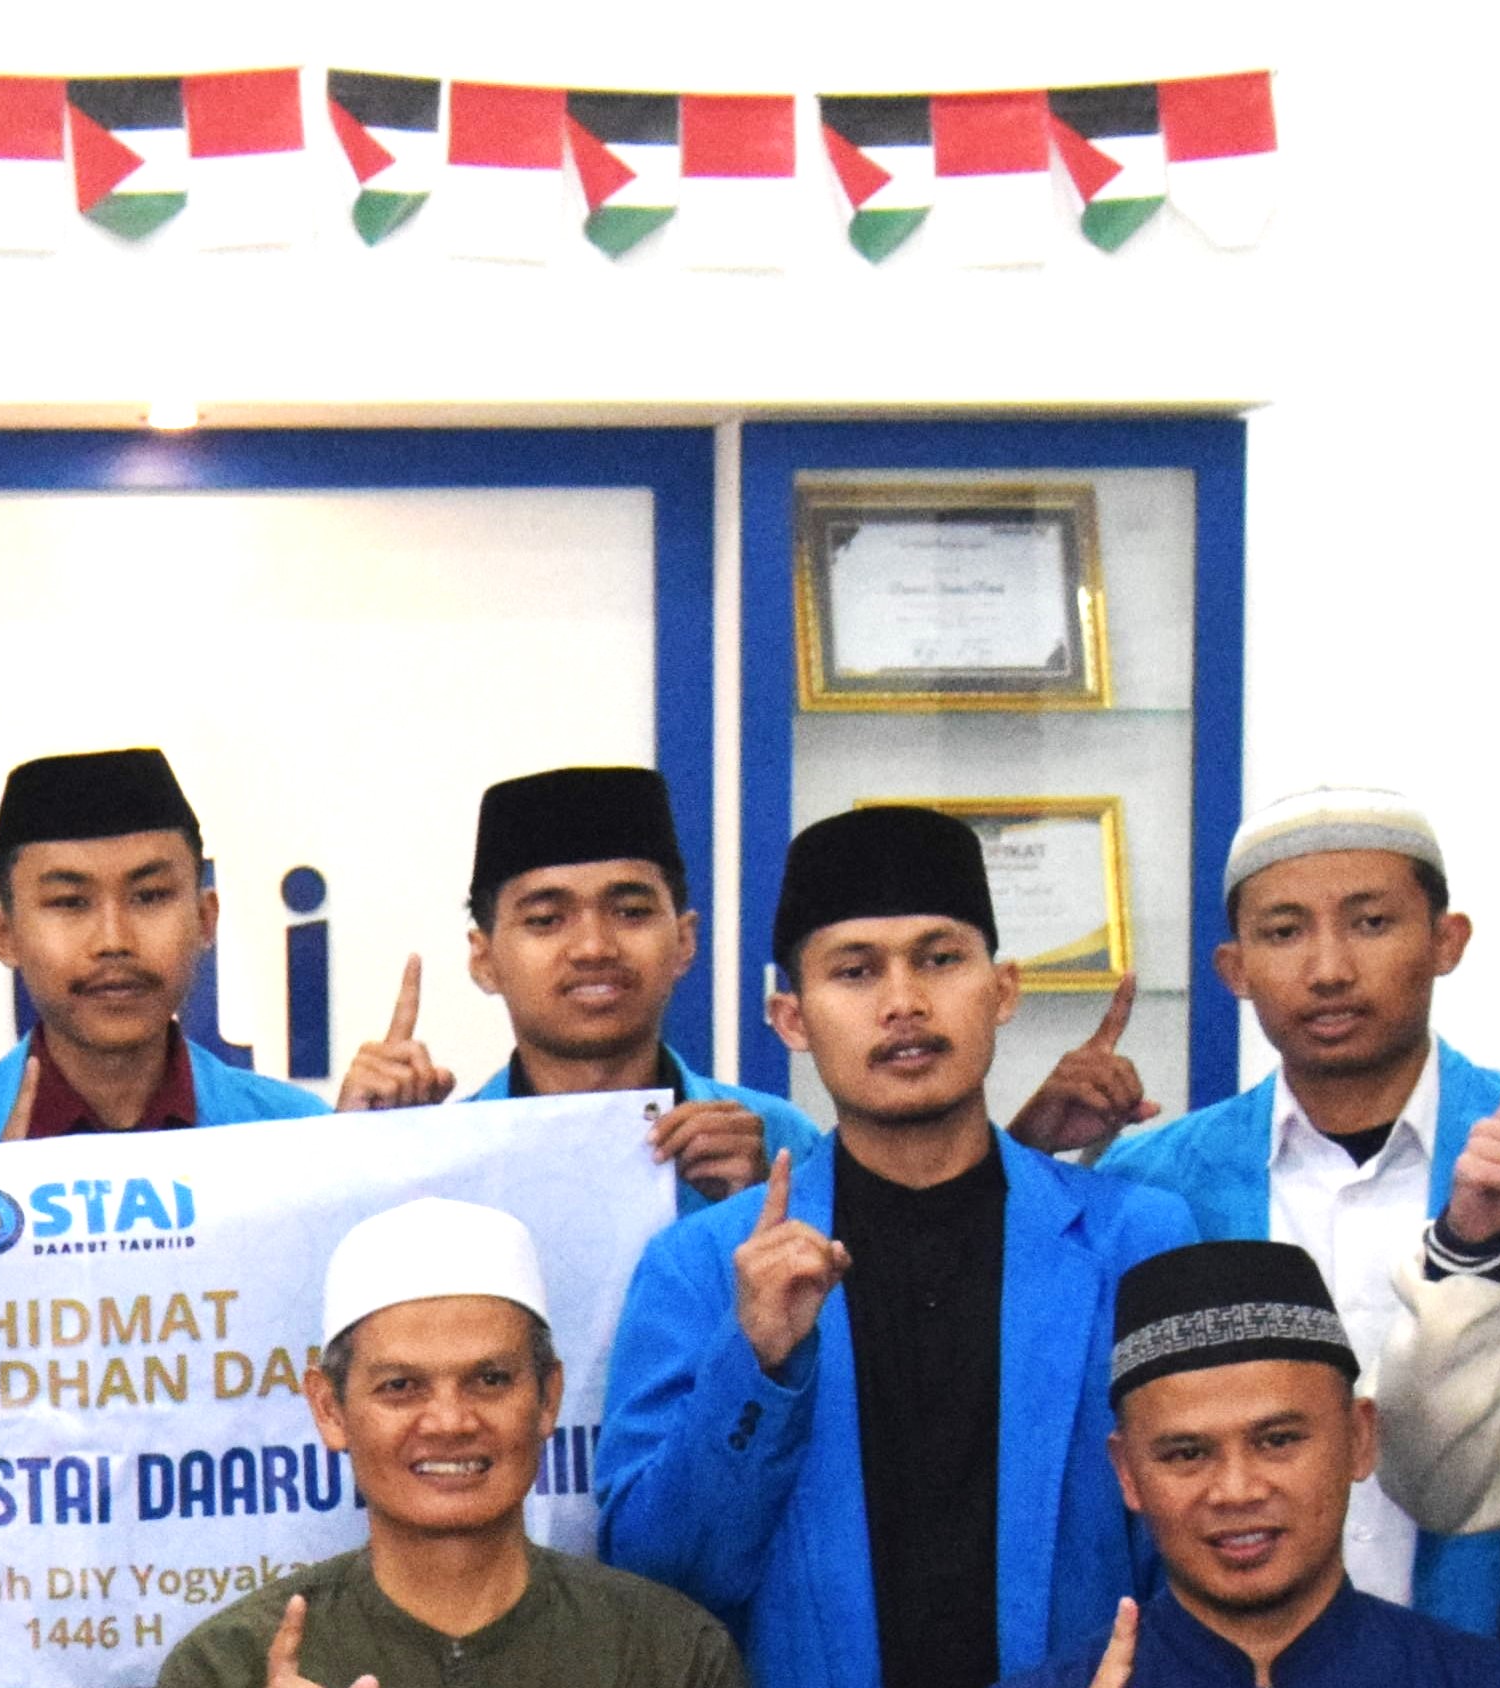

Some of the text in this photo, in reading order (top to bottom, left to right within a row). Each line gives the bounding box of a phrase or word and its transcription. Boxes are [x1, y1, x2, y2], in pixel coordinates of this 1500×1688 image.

[29, 1176, 196, 1238] STAI
[33, 1235, 196, 1256] DAARUT TAUHIID
[136, 1442, 367, 1521] DAARU
[47, 1565, 117, 1601] DIY
[130, 1555, 307, 1605] Yogyak
[23, 1612, 164, 1650] 1446 H
